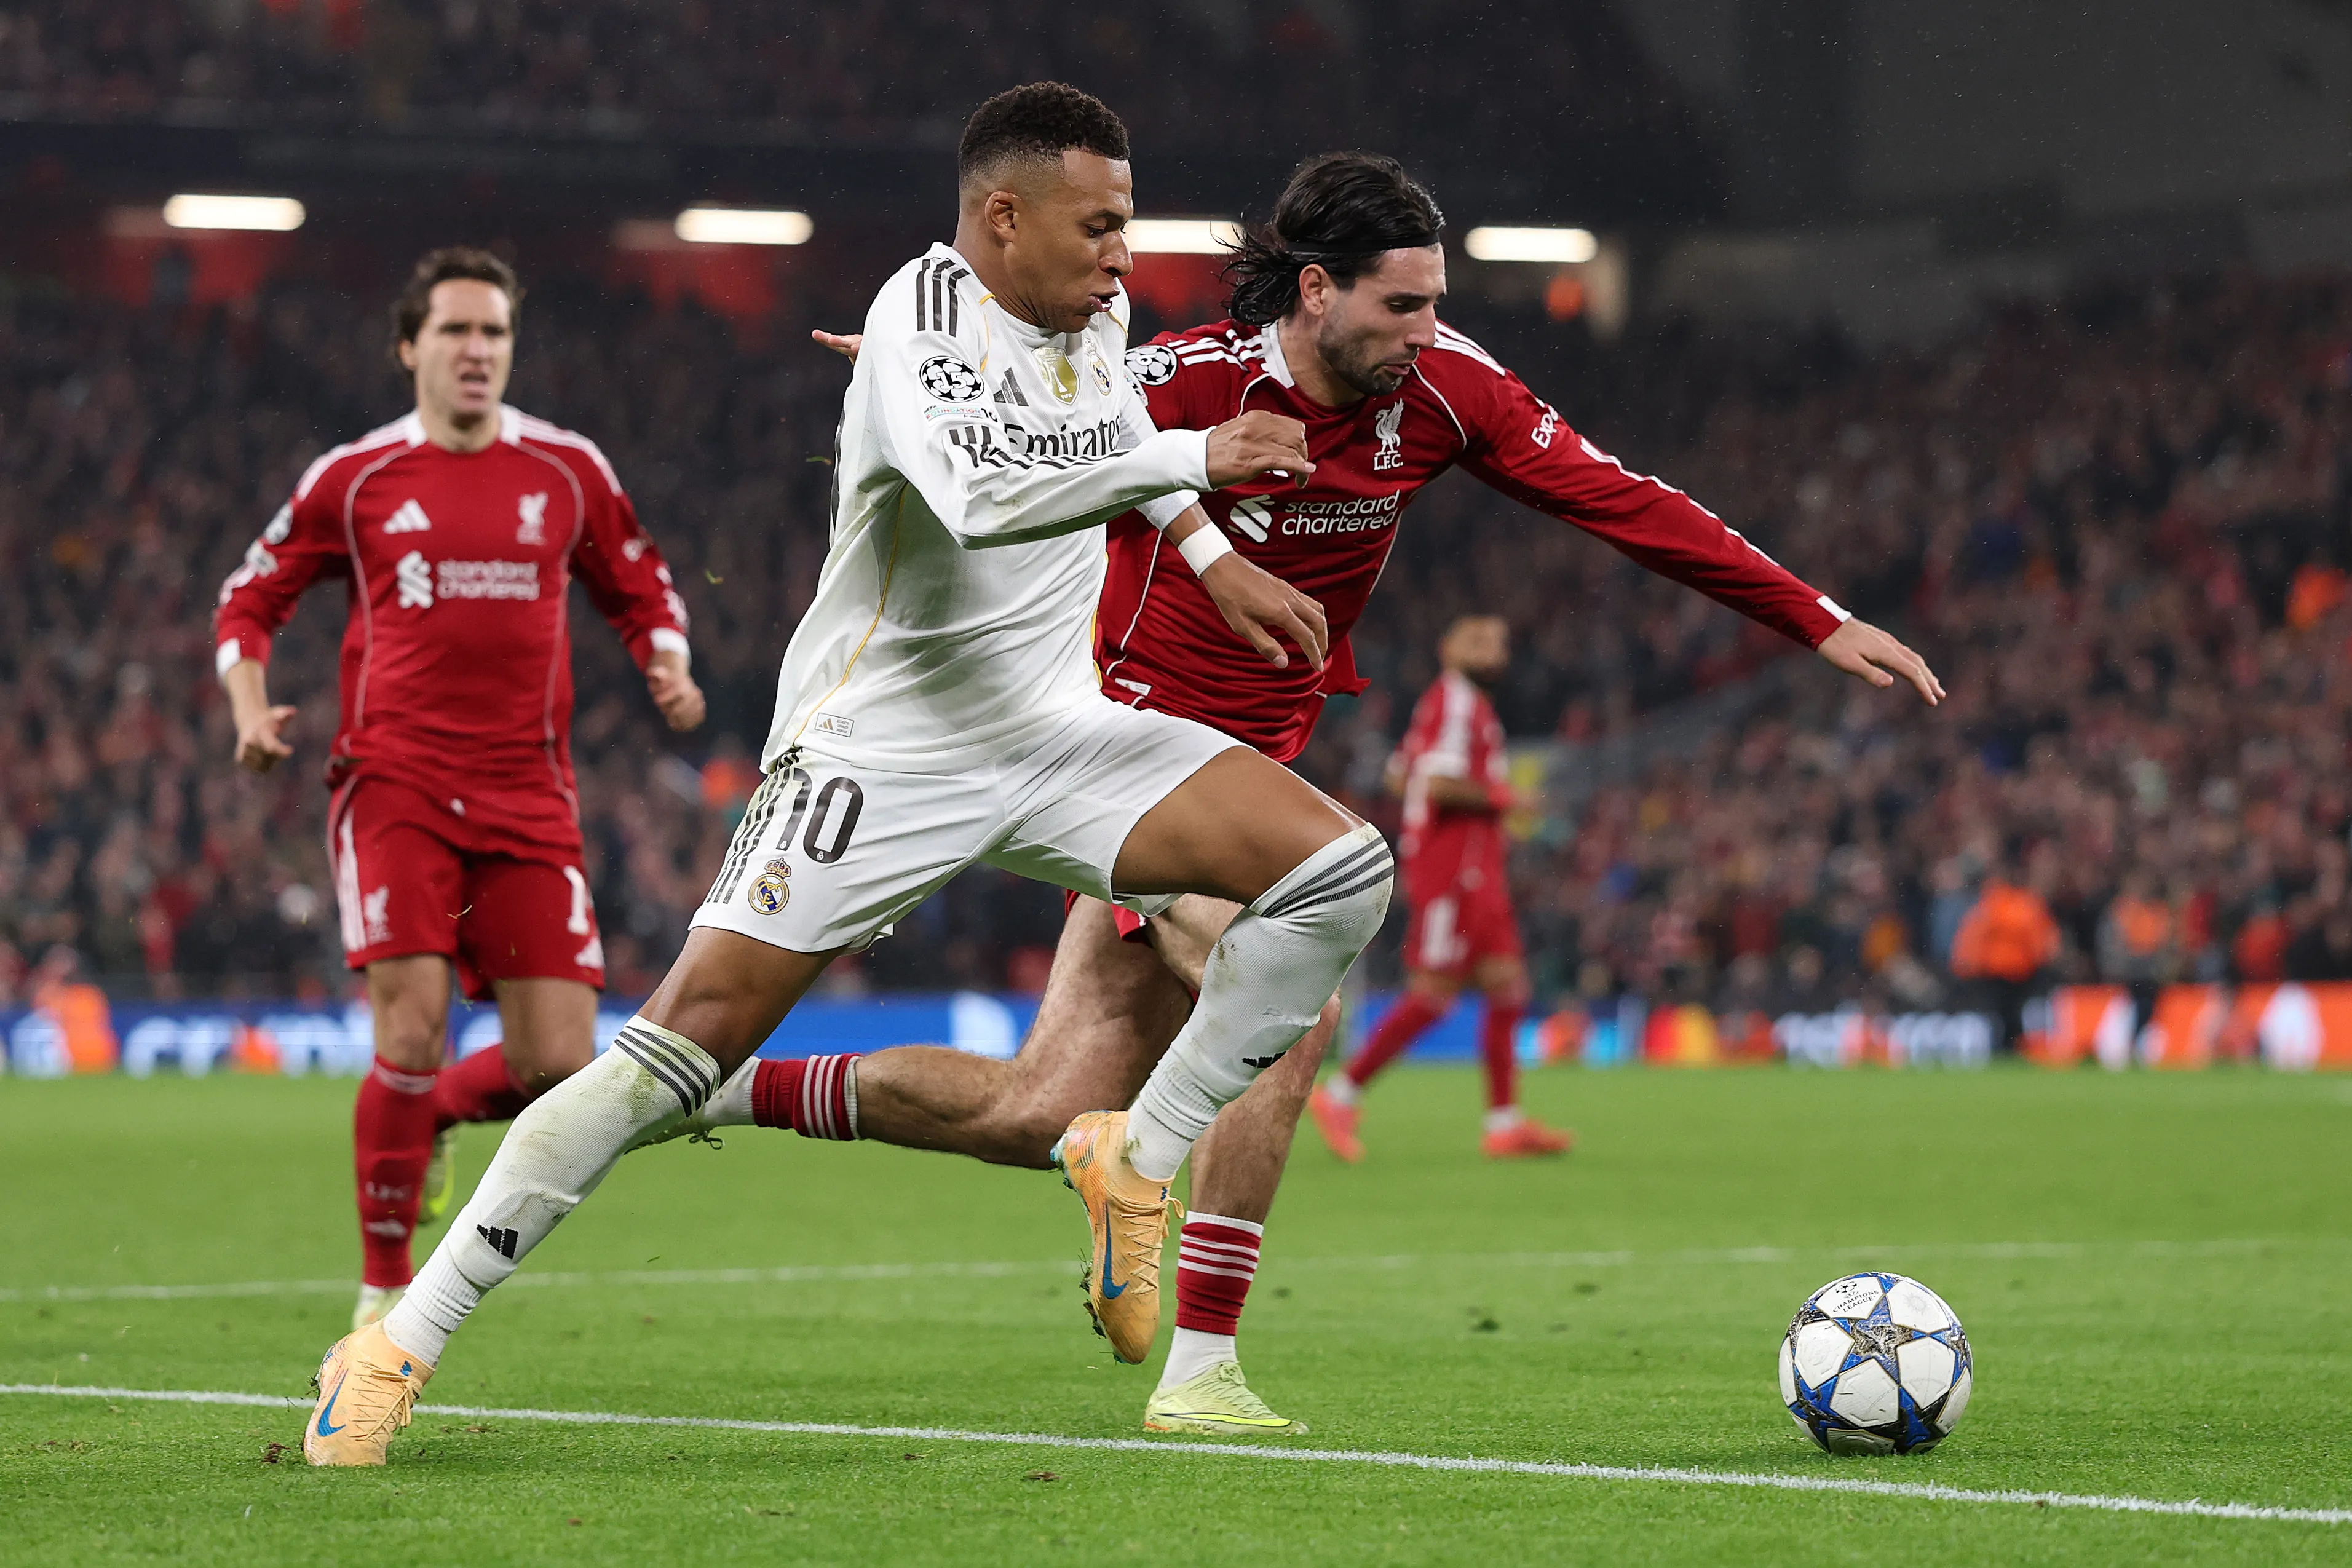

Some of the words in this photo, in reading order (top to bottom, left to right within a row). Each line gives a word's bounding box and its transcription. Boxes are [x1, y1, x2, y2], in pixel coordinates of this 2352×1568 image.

[935, 371, 967, 390] 15
[1285, 489, 1400, 515] standard
[1281, 506, 1398, 536] chartered
[776, 767, 864, 864] 10
[1833, 1290, 1879, 1312] CHAMPIONS
[1843, 1296, 1874, 1312] LEAGUE
